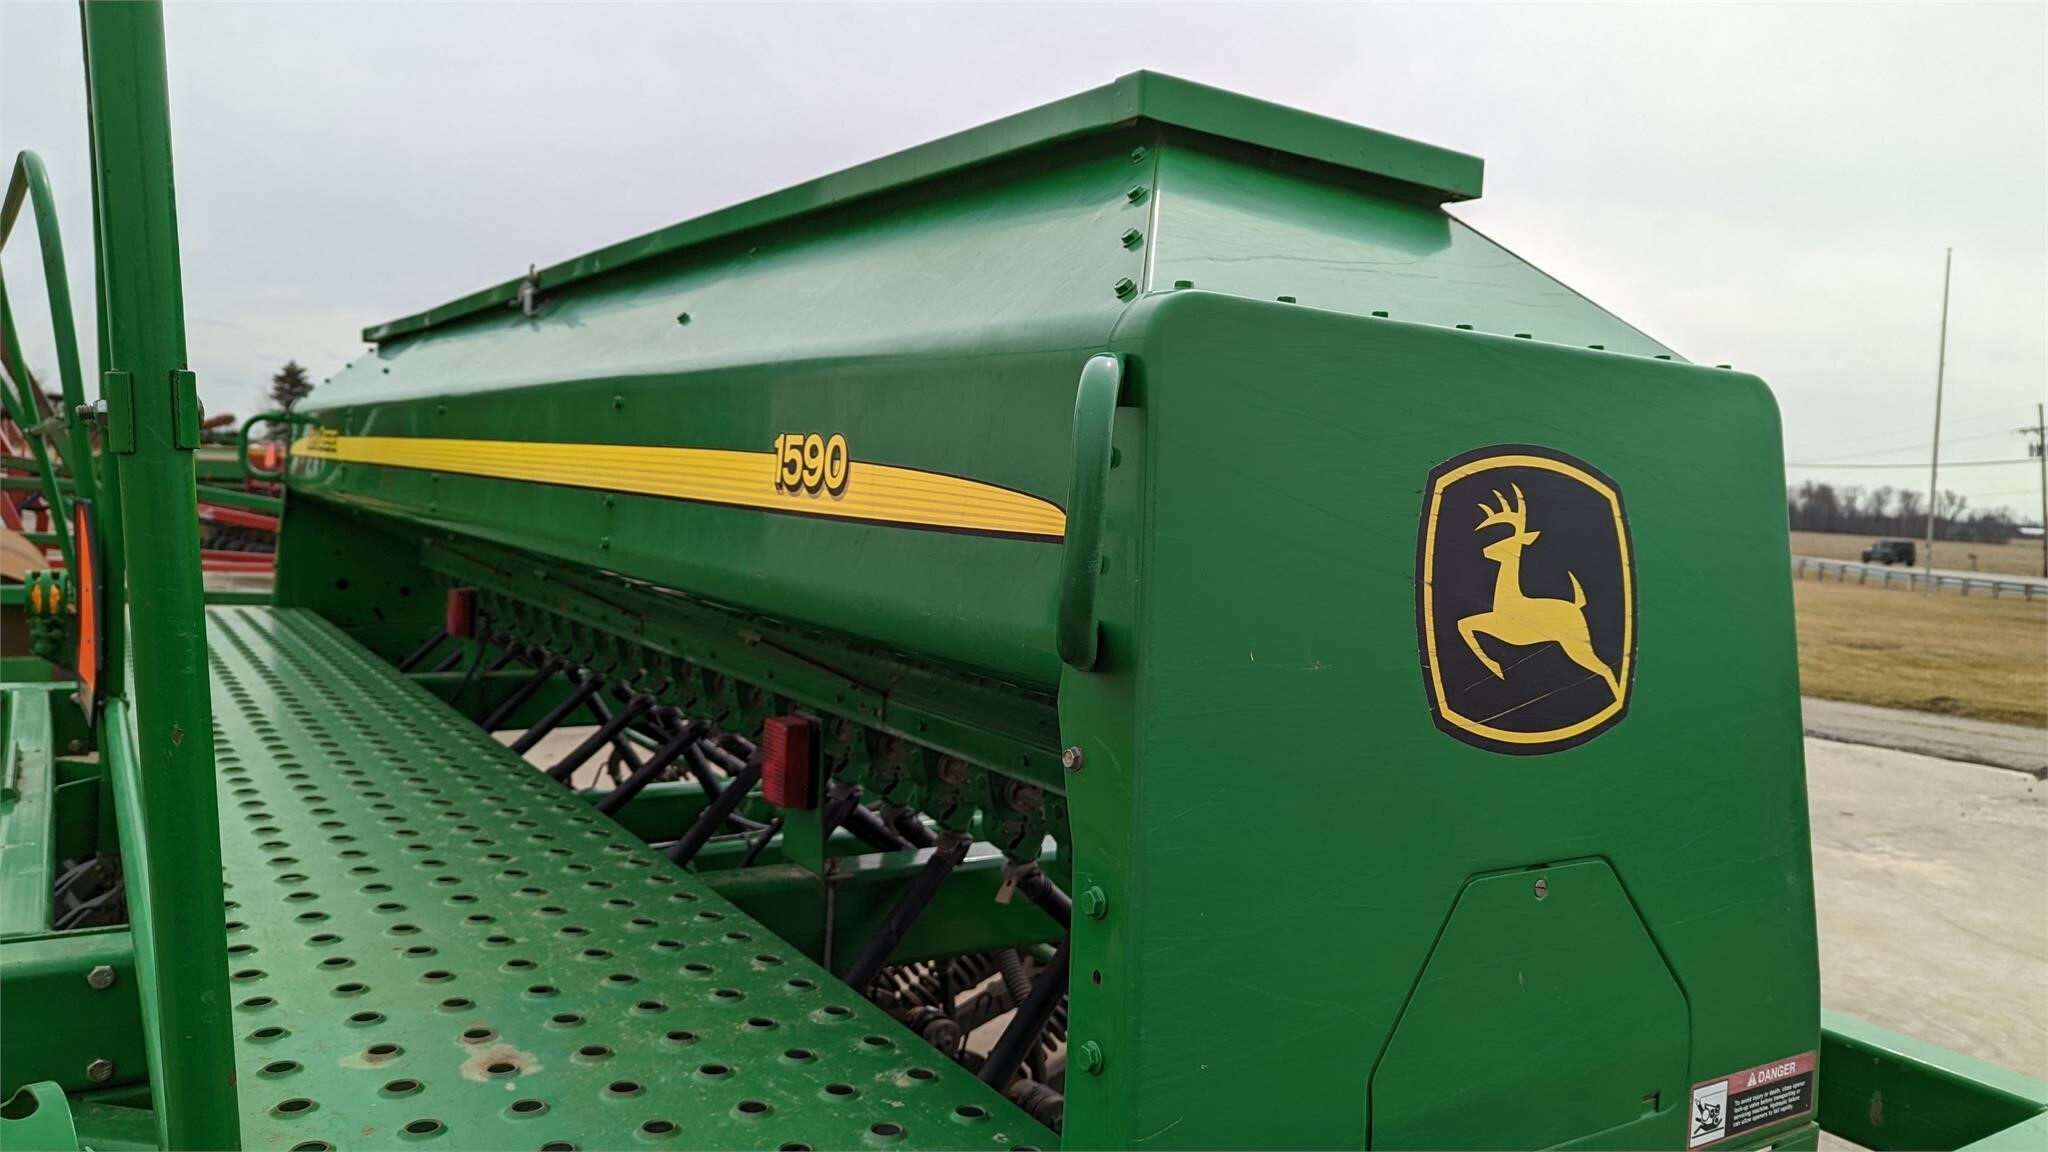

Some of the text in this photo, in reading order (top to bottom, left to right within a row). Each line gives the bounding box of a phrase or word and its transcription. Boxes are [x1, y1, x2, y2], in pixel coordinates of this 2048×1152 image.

[774, 431, 849, 497] 1590
[1758, 1062, 1796, 1083] DANGER
[1741, 1097, 1752, 1105] avoid
[1752, 1094, 1764, 1102] injury
[1773, 1090, 1796, 1101] transporting
